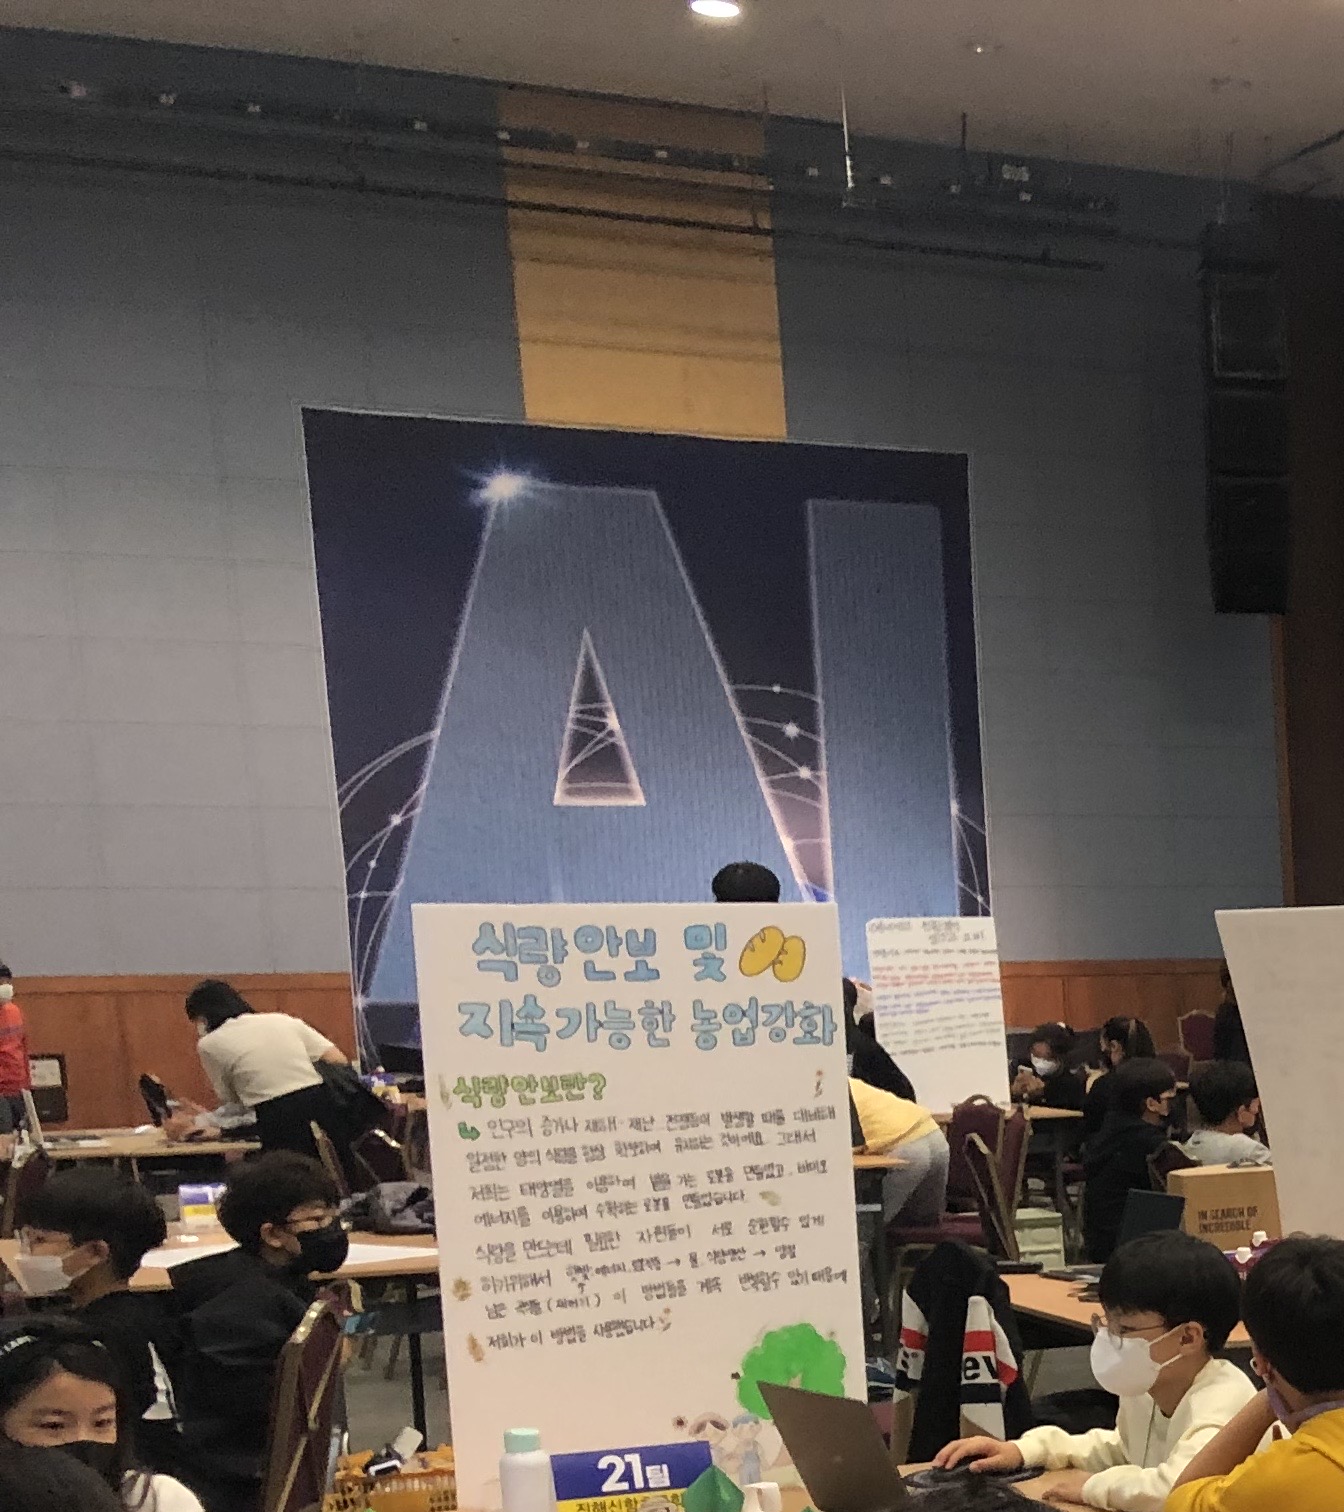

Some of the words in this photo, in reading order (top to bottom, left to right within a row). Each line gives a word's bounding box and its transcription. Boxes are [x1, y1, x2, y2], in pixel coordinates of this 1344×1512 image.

[471, 920, 660, 988] 식량안보
[683, 922, 728, 983] 및
[452, 1072, 608, 1110] 식량안보란?
